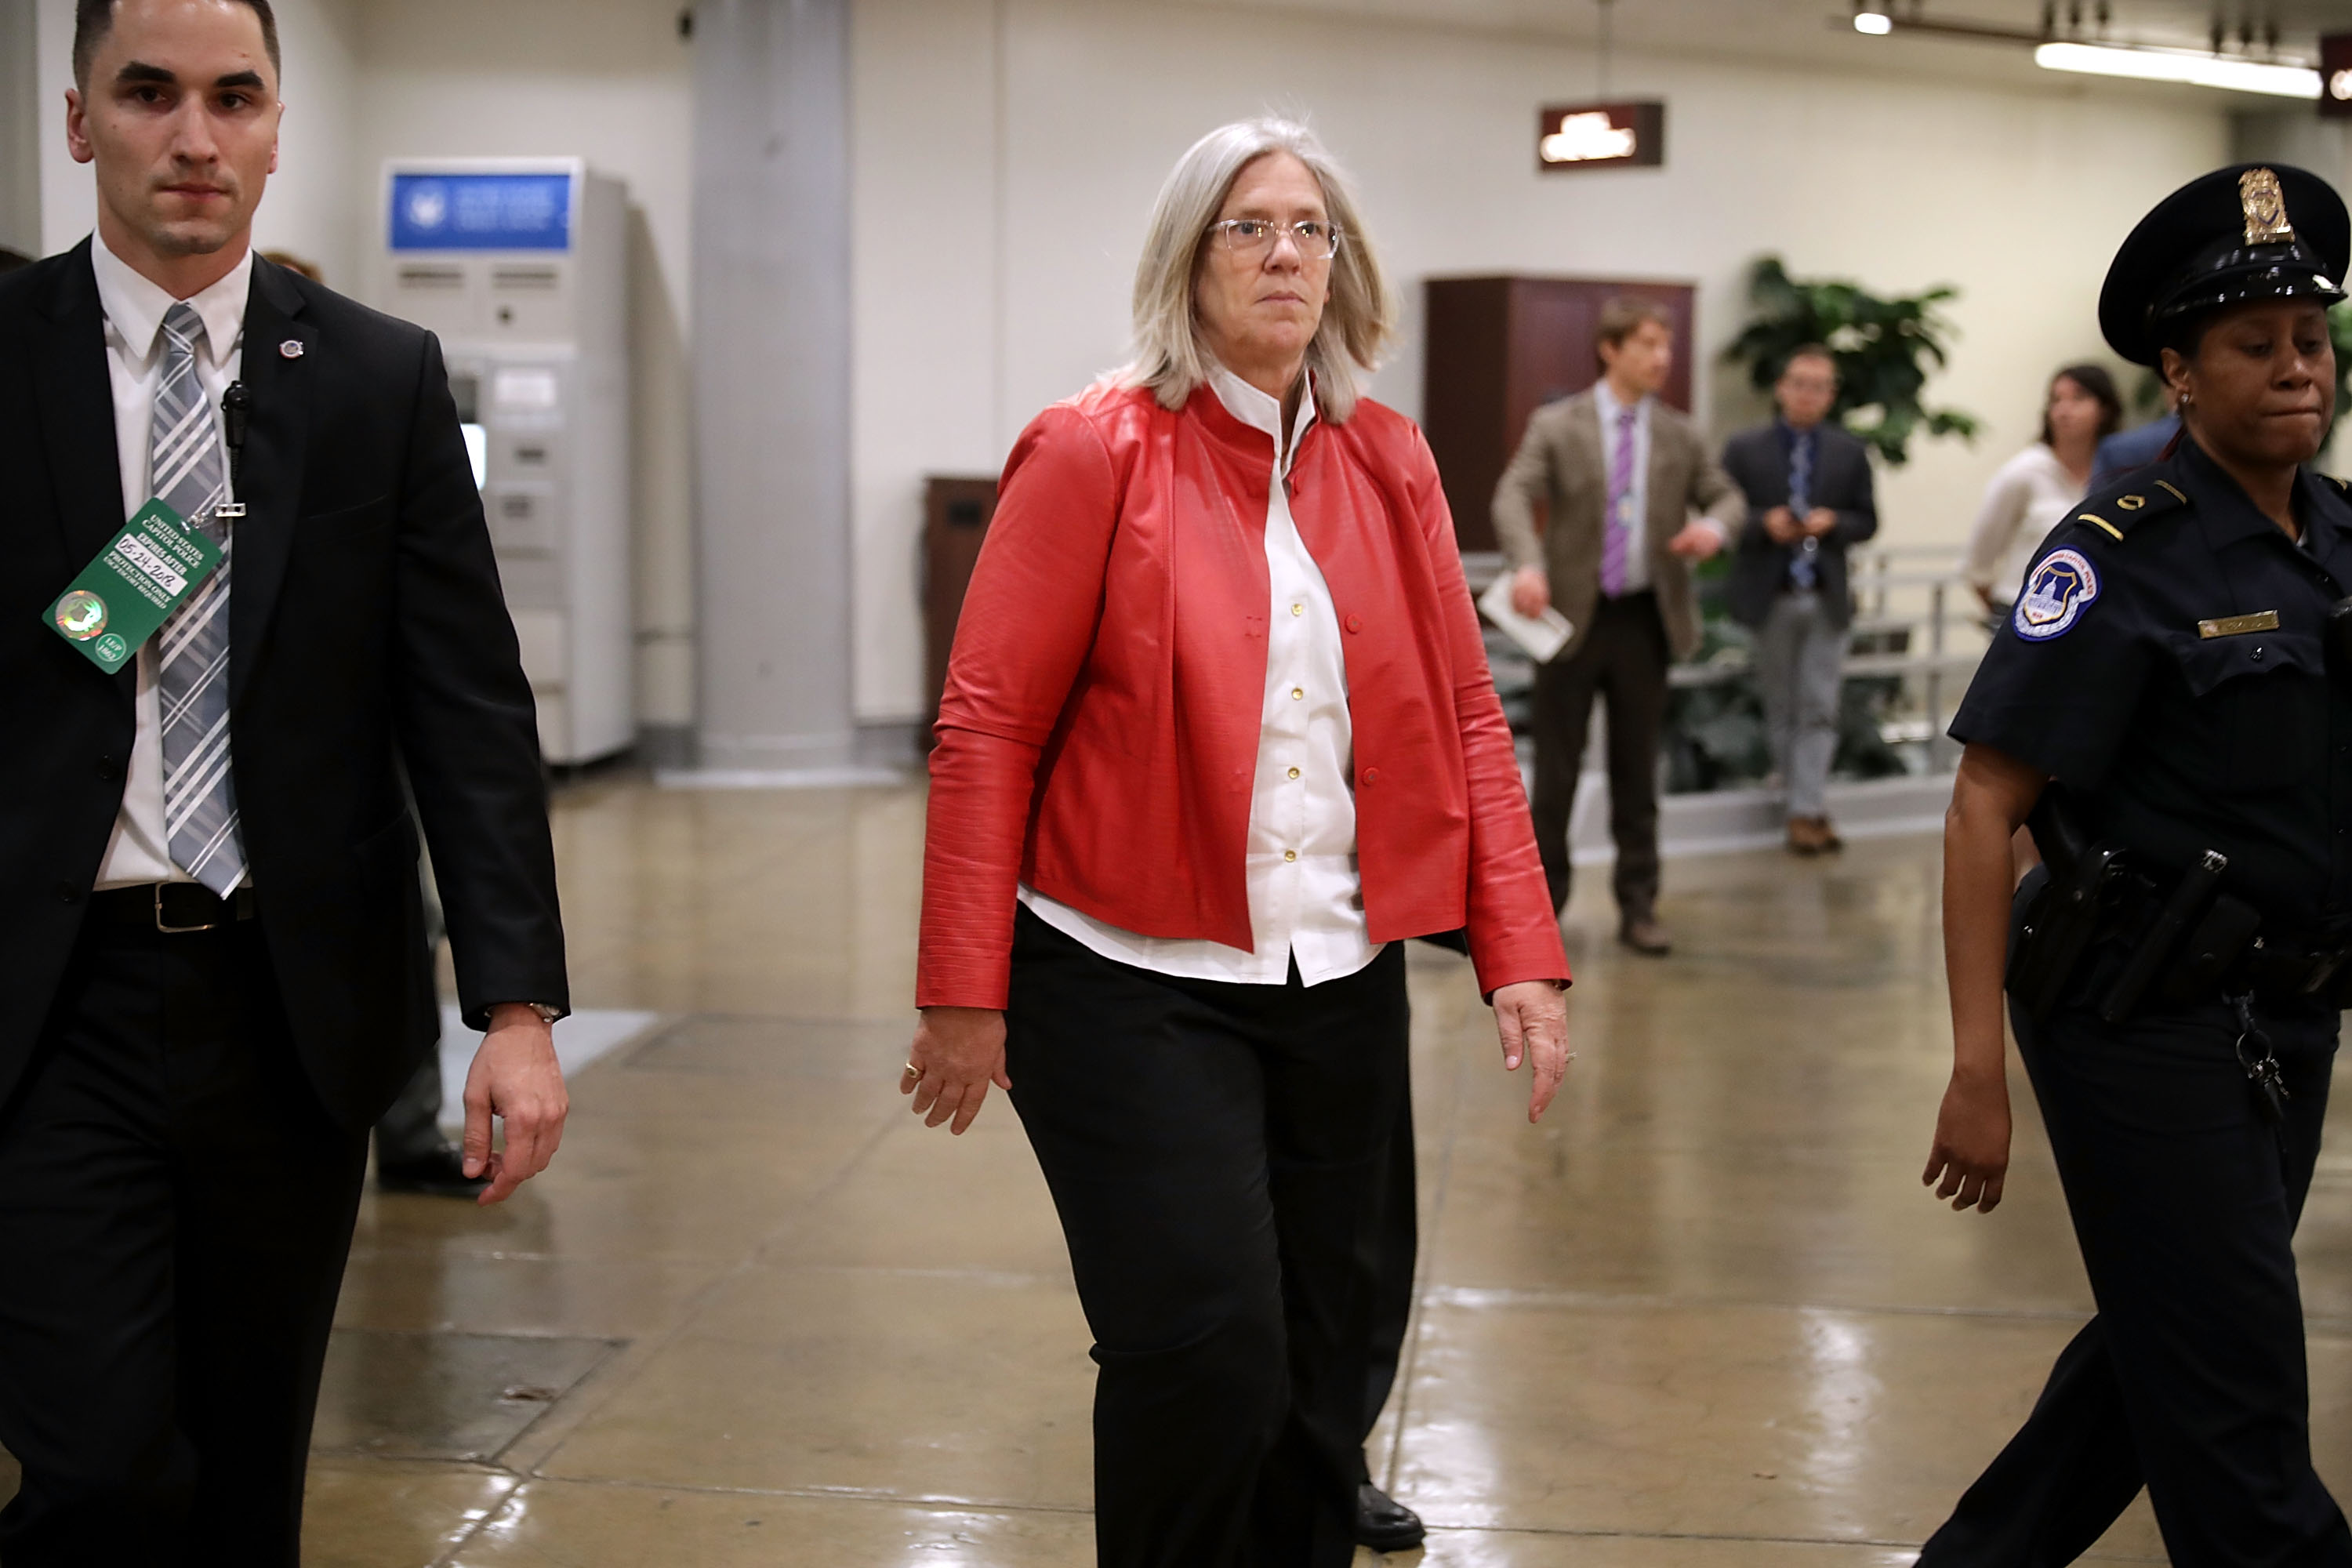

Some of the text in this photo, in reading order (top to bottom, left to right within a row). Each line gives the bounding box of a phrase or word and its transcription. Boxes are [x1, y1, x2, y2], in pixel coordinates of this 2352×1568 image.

[137, 532, 187, 575] EXPIRES AFTER
[142, 519, 200, 568] CAPITOL POLICE
[151, 514, 204, 561] UNITED STATES
[109, 550, 171, 603] PROTECTION ONLY
